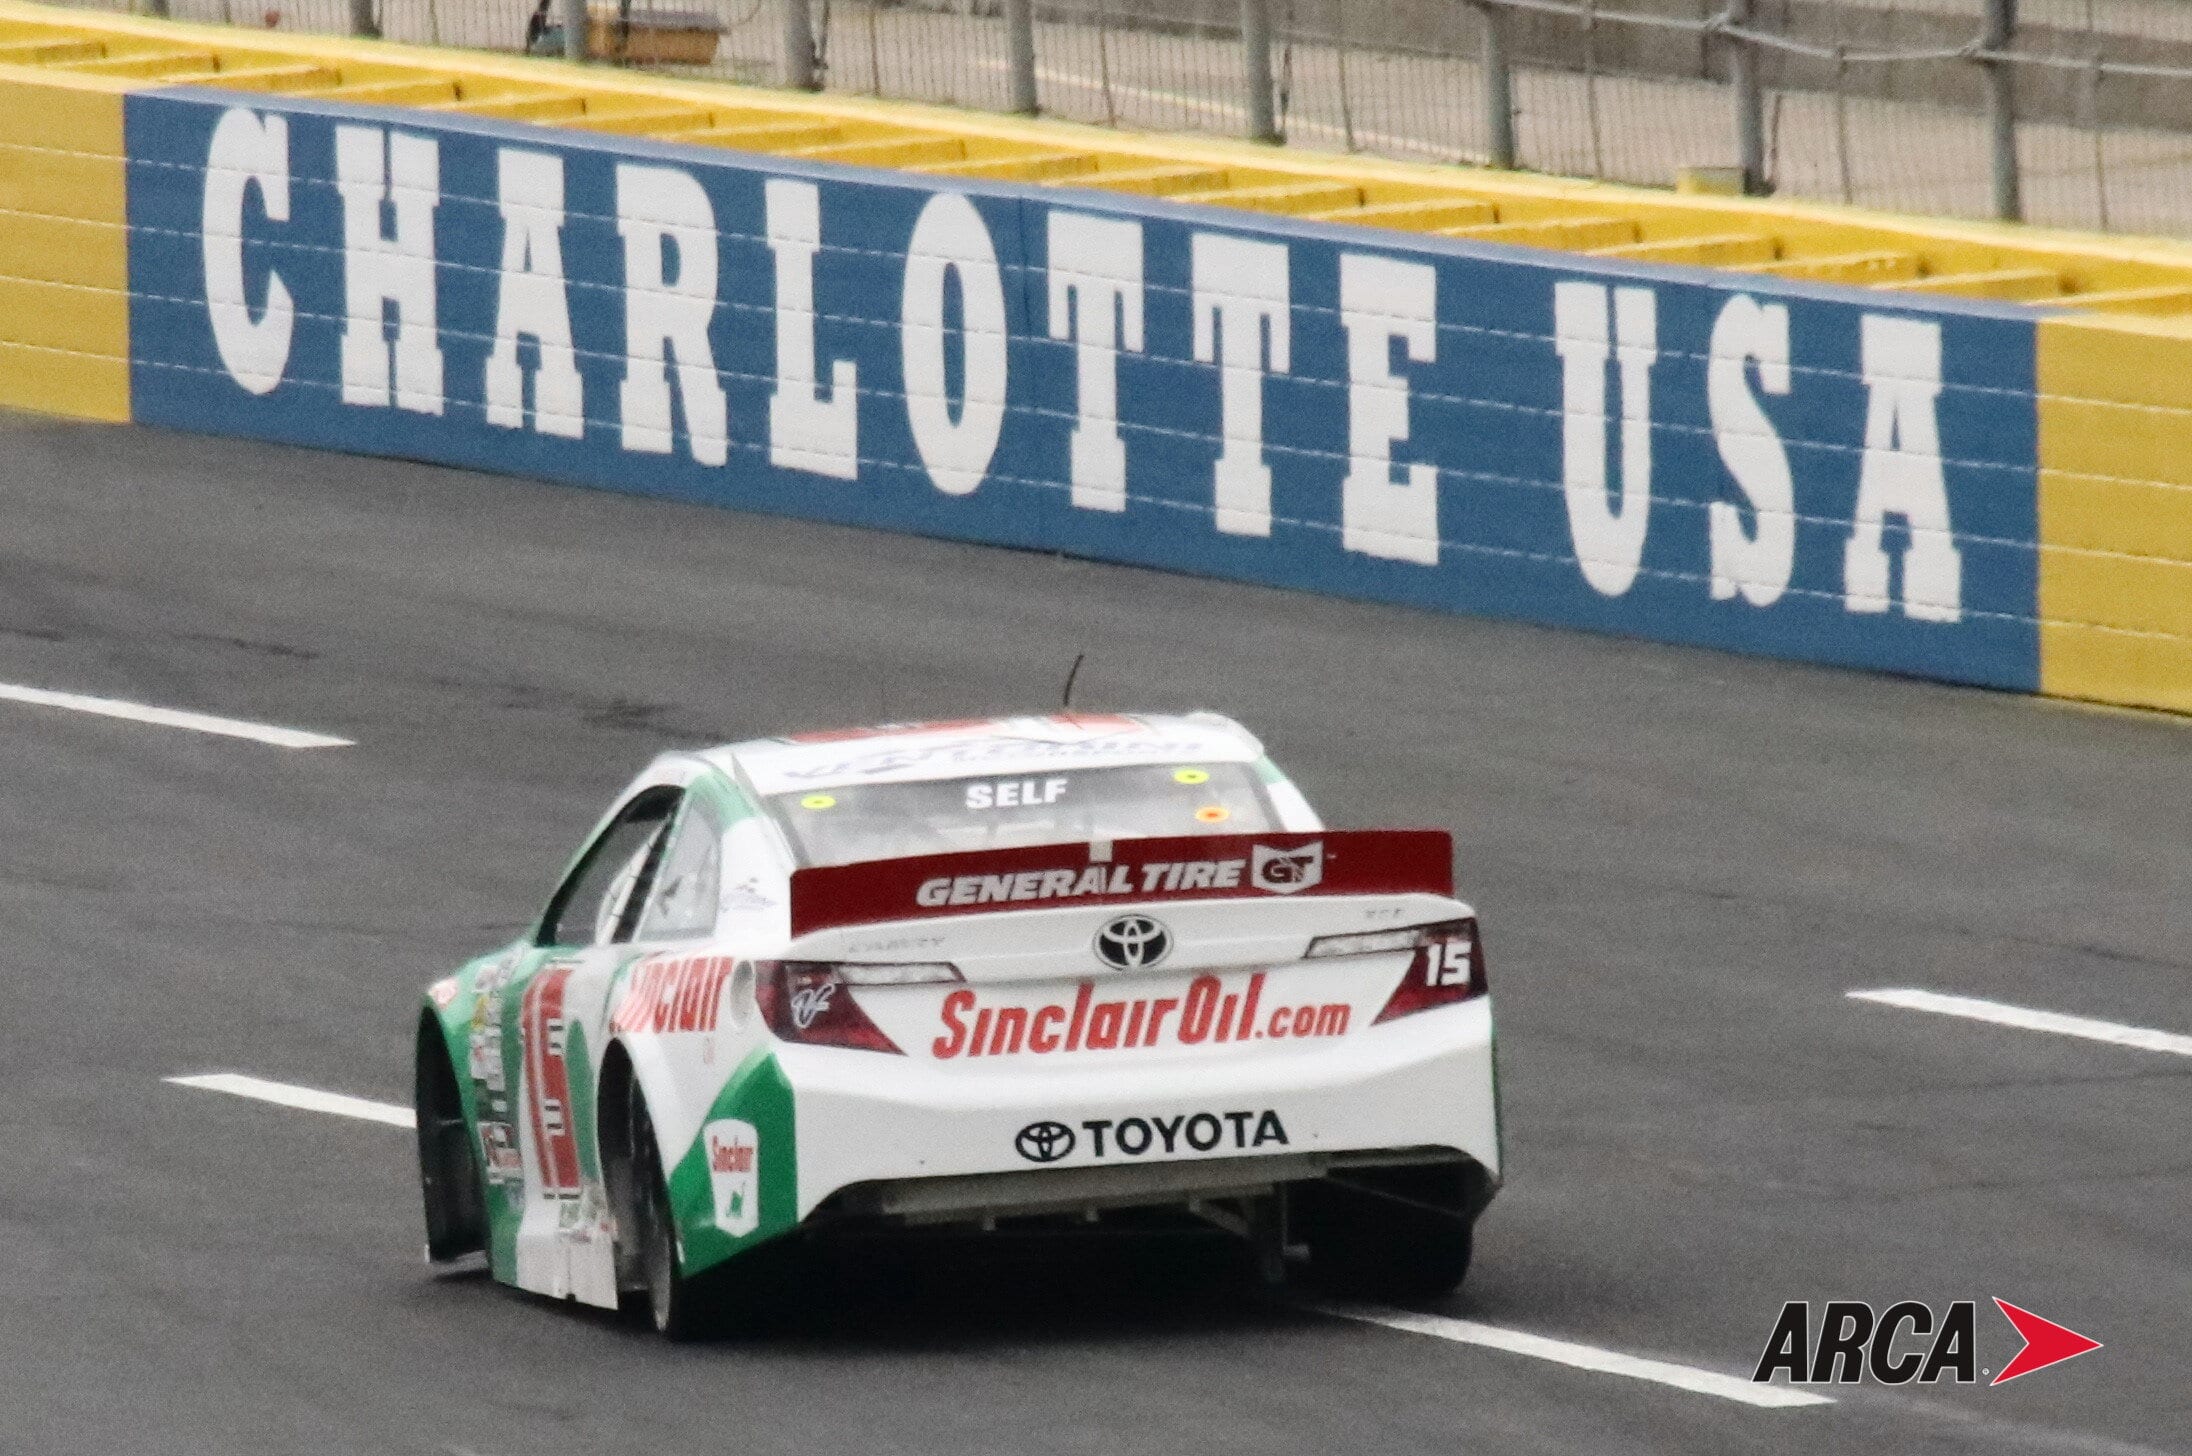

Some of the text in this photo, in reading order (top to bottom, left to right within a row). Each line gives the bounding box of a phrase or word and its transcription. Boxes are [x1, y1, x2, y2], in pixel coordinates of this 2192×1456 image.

[202, 107, 1962, 622] CHARLOTTE USA
[965, 778, 1069, 809] SELF
[915, 859, 1247, 907] GENERAL TIRE
[1425, 941, 1472, 987] 15
[931, 972, 1352, 1060] SinclairOil.com
[1082, 1109, 1290, 1157] TOYOTA
